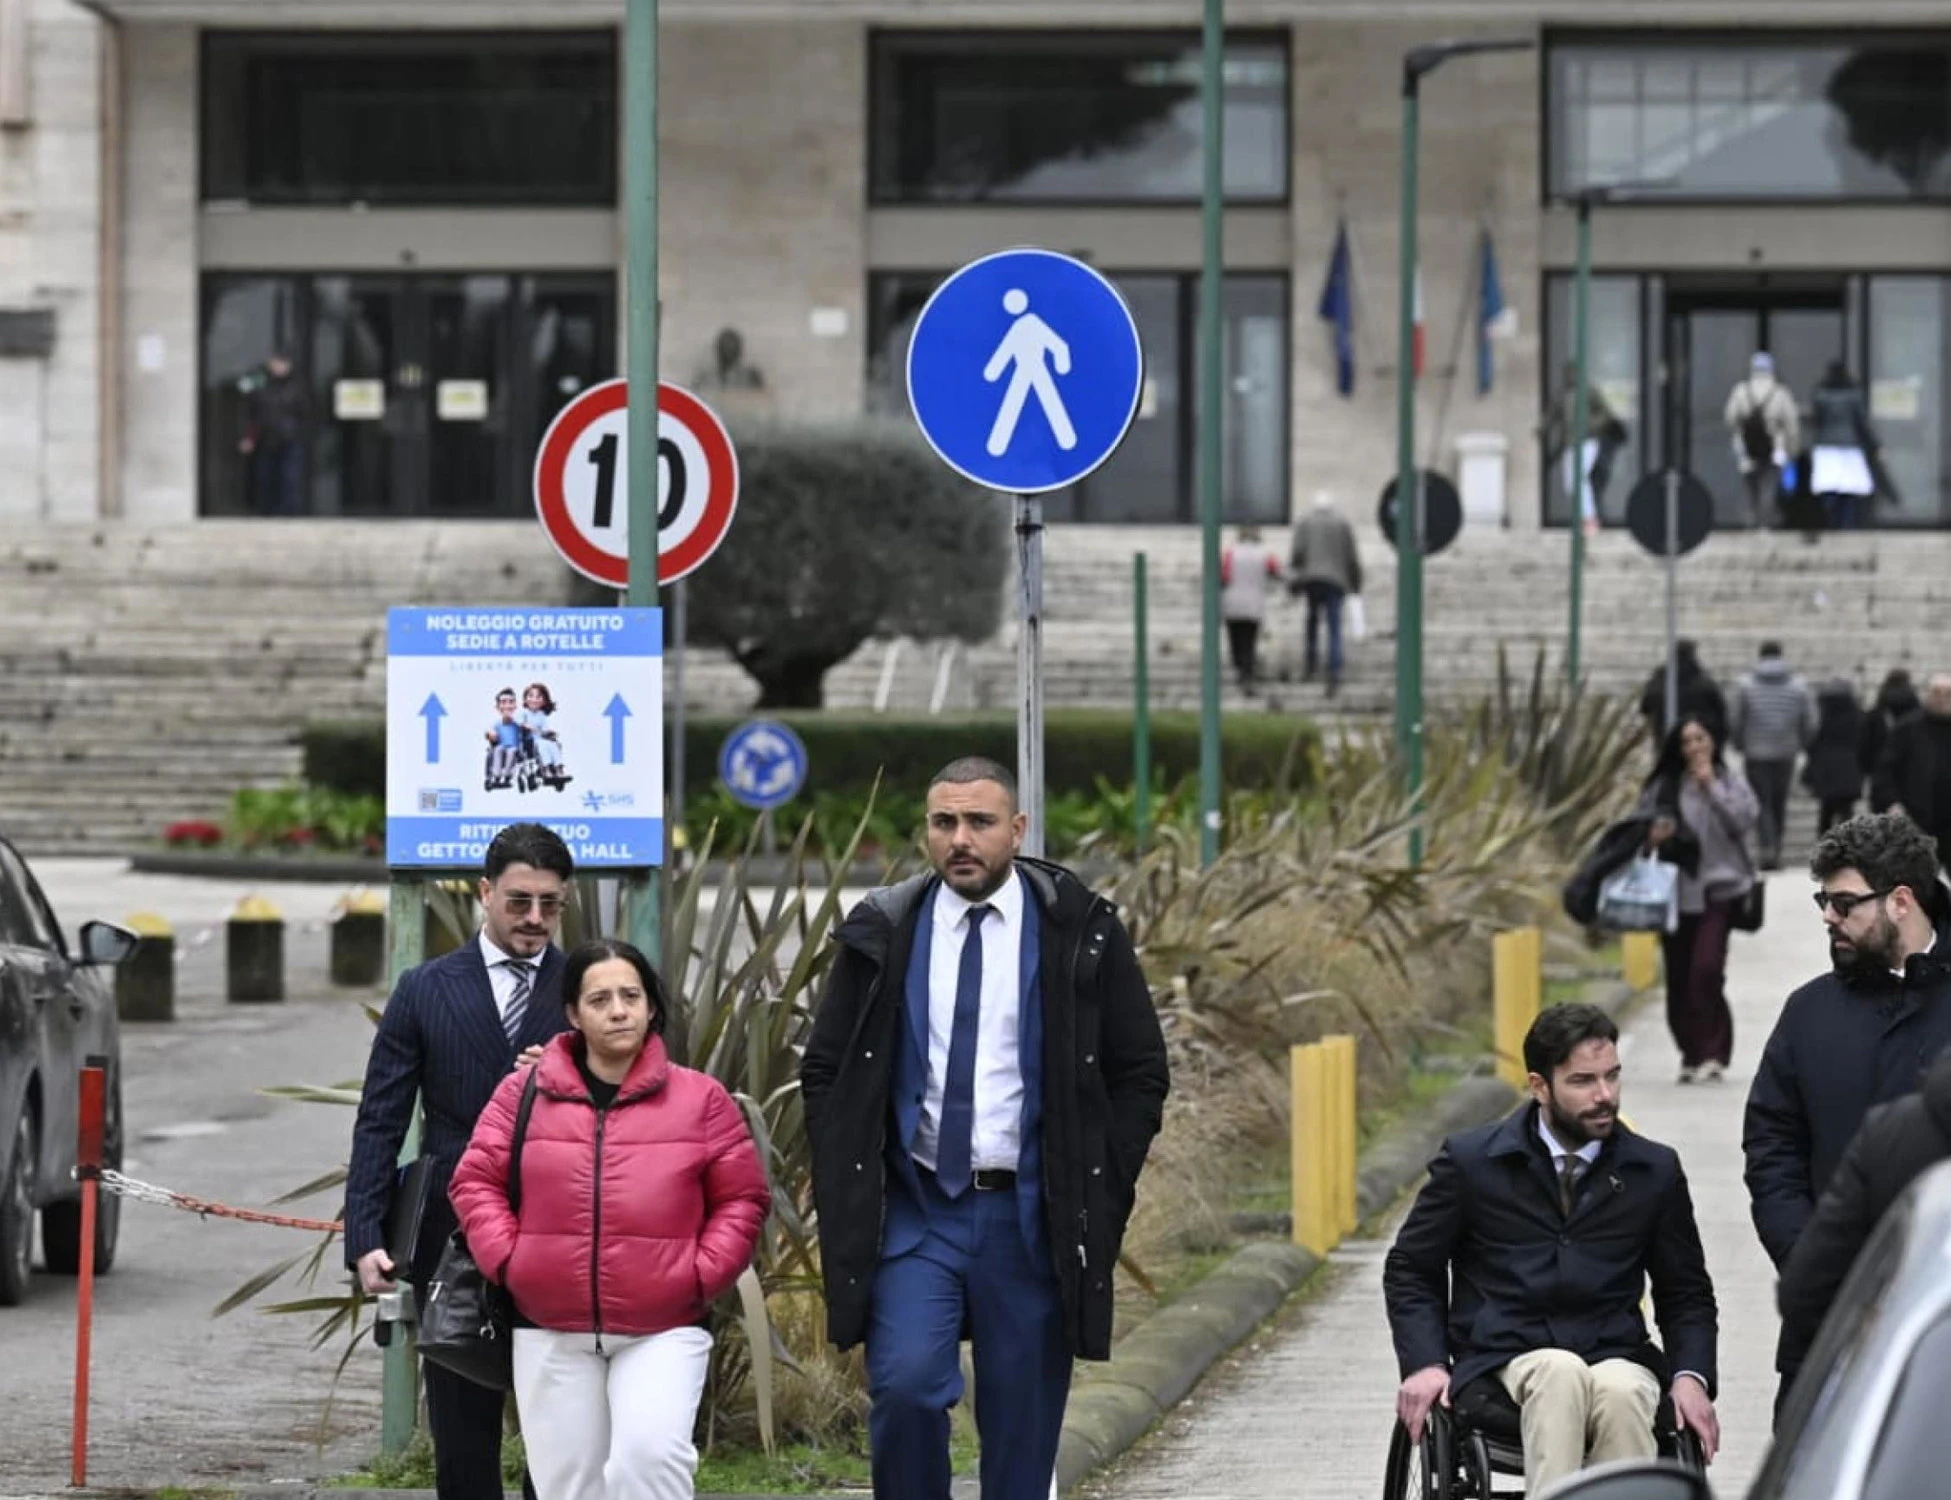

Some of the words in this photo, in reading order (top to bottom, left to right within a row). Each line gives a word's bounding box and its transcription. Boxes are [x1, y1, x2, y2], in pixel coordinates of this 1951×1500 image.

[588, 433, 687, 531] 10
[426, 614, 525, 630] NOLEGGIO
[528, 614, 624, 630] GRATUITO
[446, 634, 499, 650] SEDIE
[504, 634, 518, 650] A
[521, 634, 604, 650] ROTELLE
[521, 660, 549, 672] PER
[557, 660, 604, 672] TUTTI
[417, 843, 492, 859] GETTO
[581, 843, 632, 859] HALL
